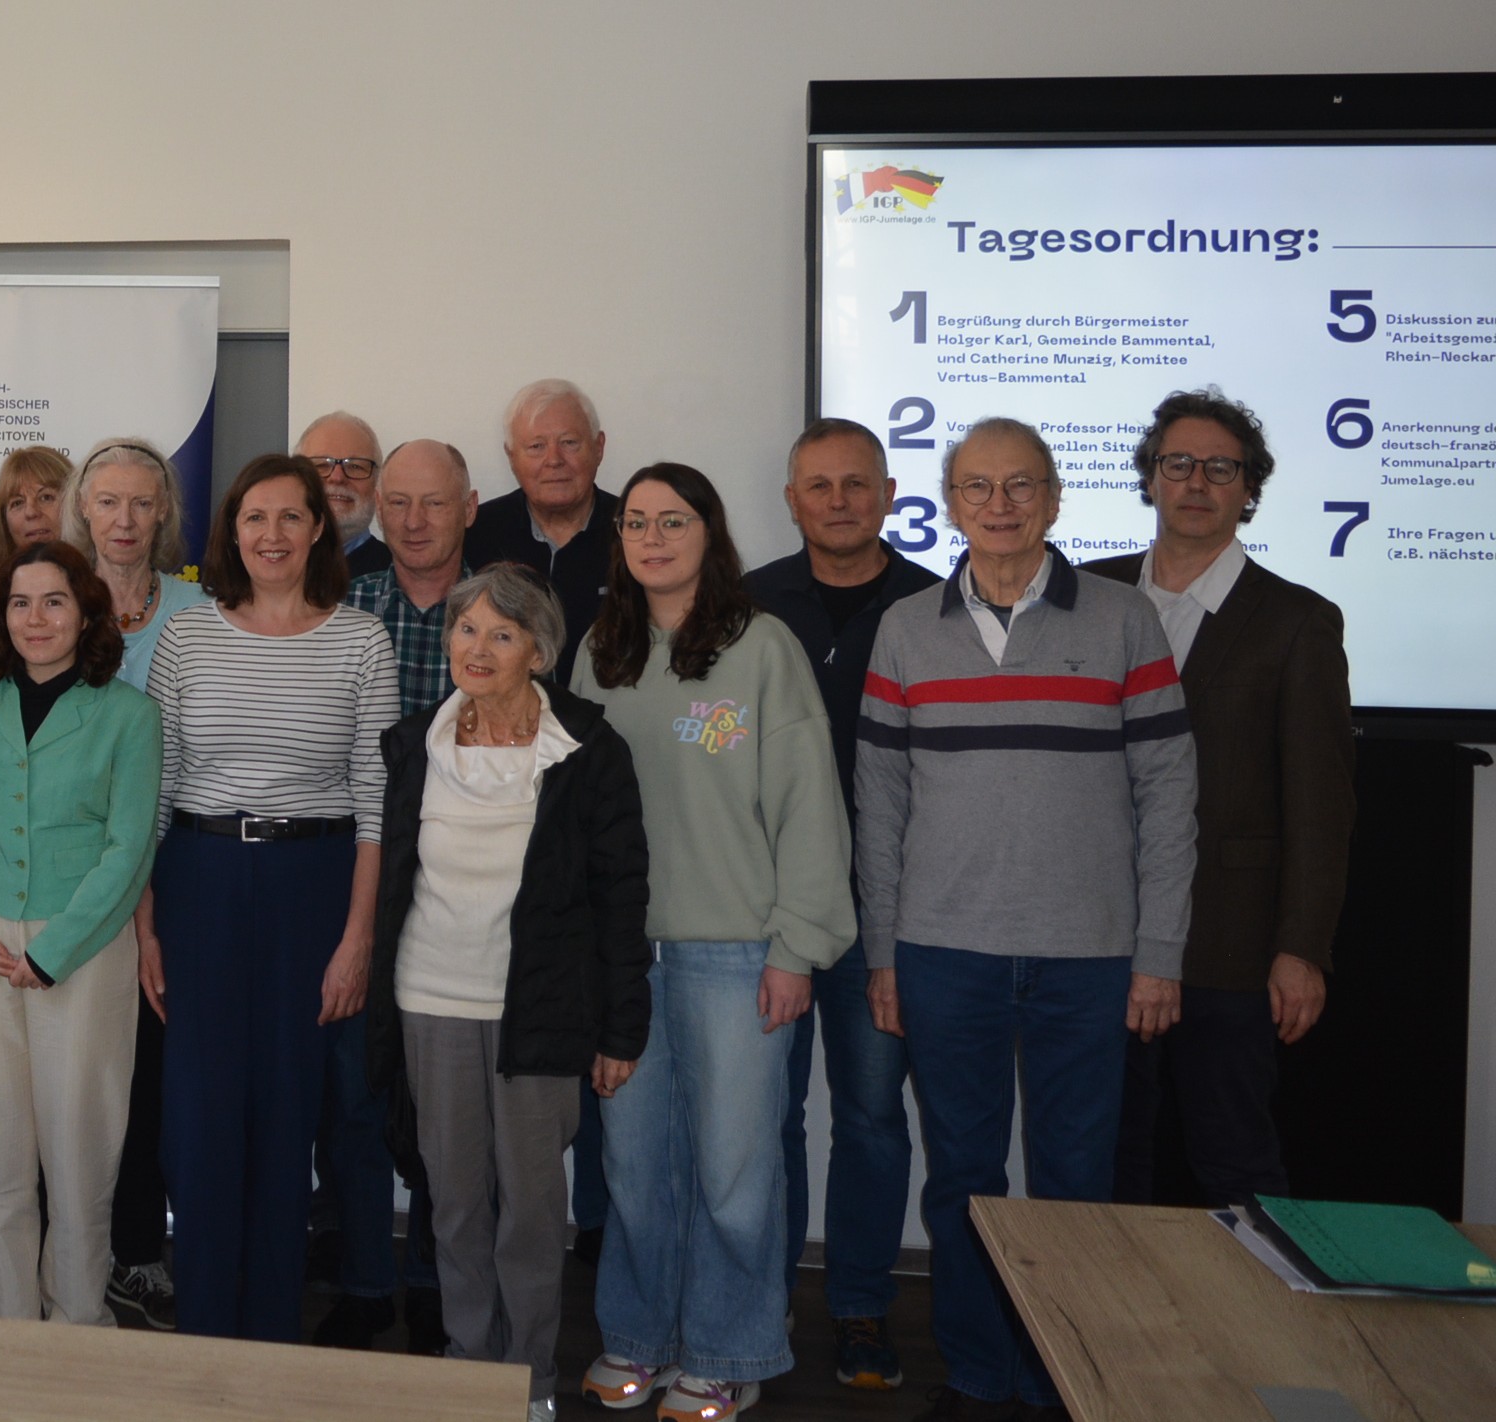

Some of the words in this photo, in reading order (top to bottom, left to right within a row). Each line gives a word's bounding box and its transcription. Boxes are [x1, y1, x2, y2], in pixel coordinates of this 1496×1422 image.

[947, 219, 1319, 261] Tagesordnung:
[889, 291, 927, 344] 1
[937, 315, 1021, 329] Begrüßung
[1025, 315, 1070, 327] durch
[1074, 315, 1189, 329] Bürgermeister
[1326, 290, 1377, 343] 5
[1386, 314, 1472, 325] Diskussion
[937, 334, 990, 348] Holger
[995, 334, 1033, 348] Karl,
[1037, 335, 1117, 346] Gemeinde
[1121, 335, 1216, 349] Bammental,
[937, 353, 966, 364] und
[970, 352, 1049, 364] Catherine
[1053, 352, 1116, 367] Munzig,
[1121, 354, 1188, 365] Komitee
[888, 396, 936, 449] 2
[946, 421, 975, 432] Vor
[1040, 422, 1112, 433] Professor
[1326, 398, 1374, 449] 6
[1381, 422, 1480, 435] Anerkennung
[1048, 441, 1098, 452] uellen
[1102, 442, 1136, 452] Situ
[1066, 462, 1083, 470] zu
[1087, 460, 1115, 470] den
[1380, 475, 1475, 488] Jumelage.eu
[886, 496, 937, 552] 3
[1323, 501, 1370, 557] 7
[1387, 528, 1423, 539] Ihre
[1428, 529, 1485, 542] Fragen
[1387, 548, 1423, 560] (z.B.
